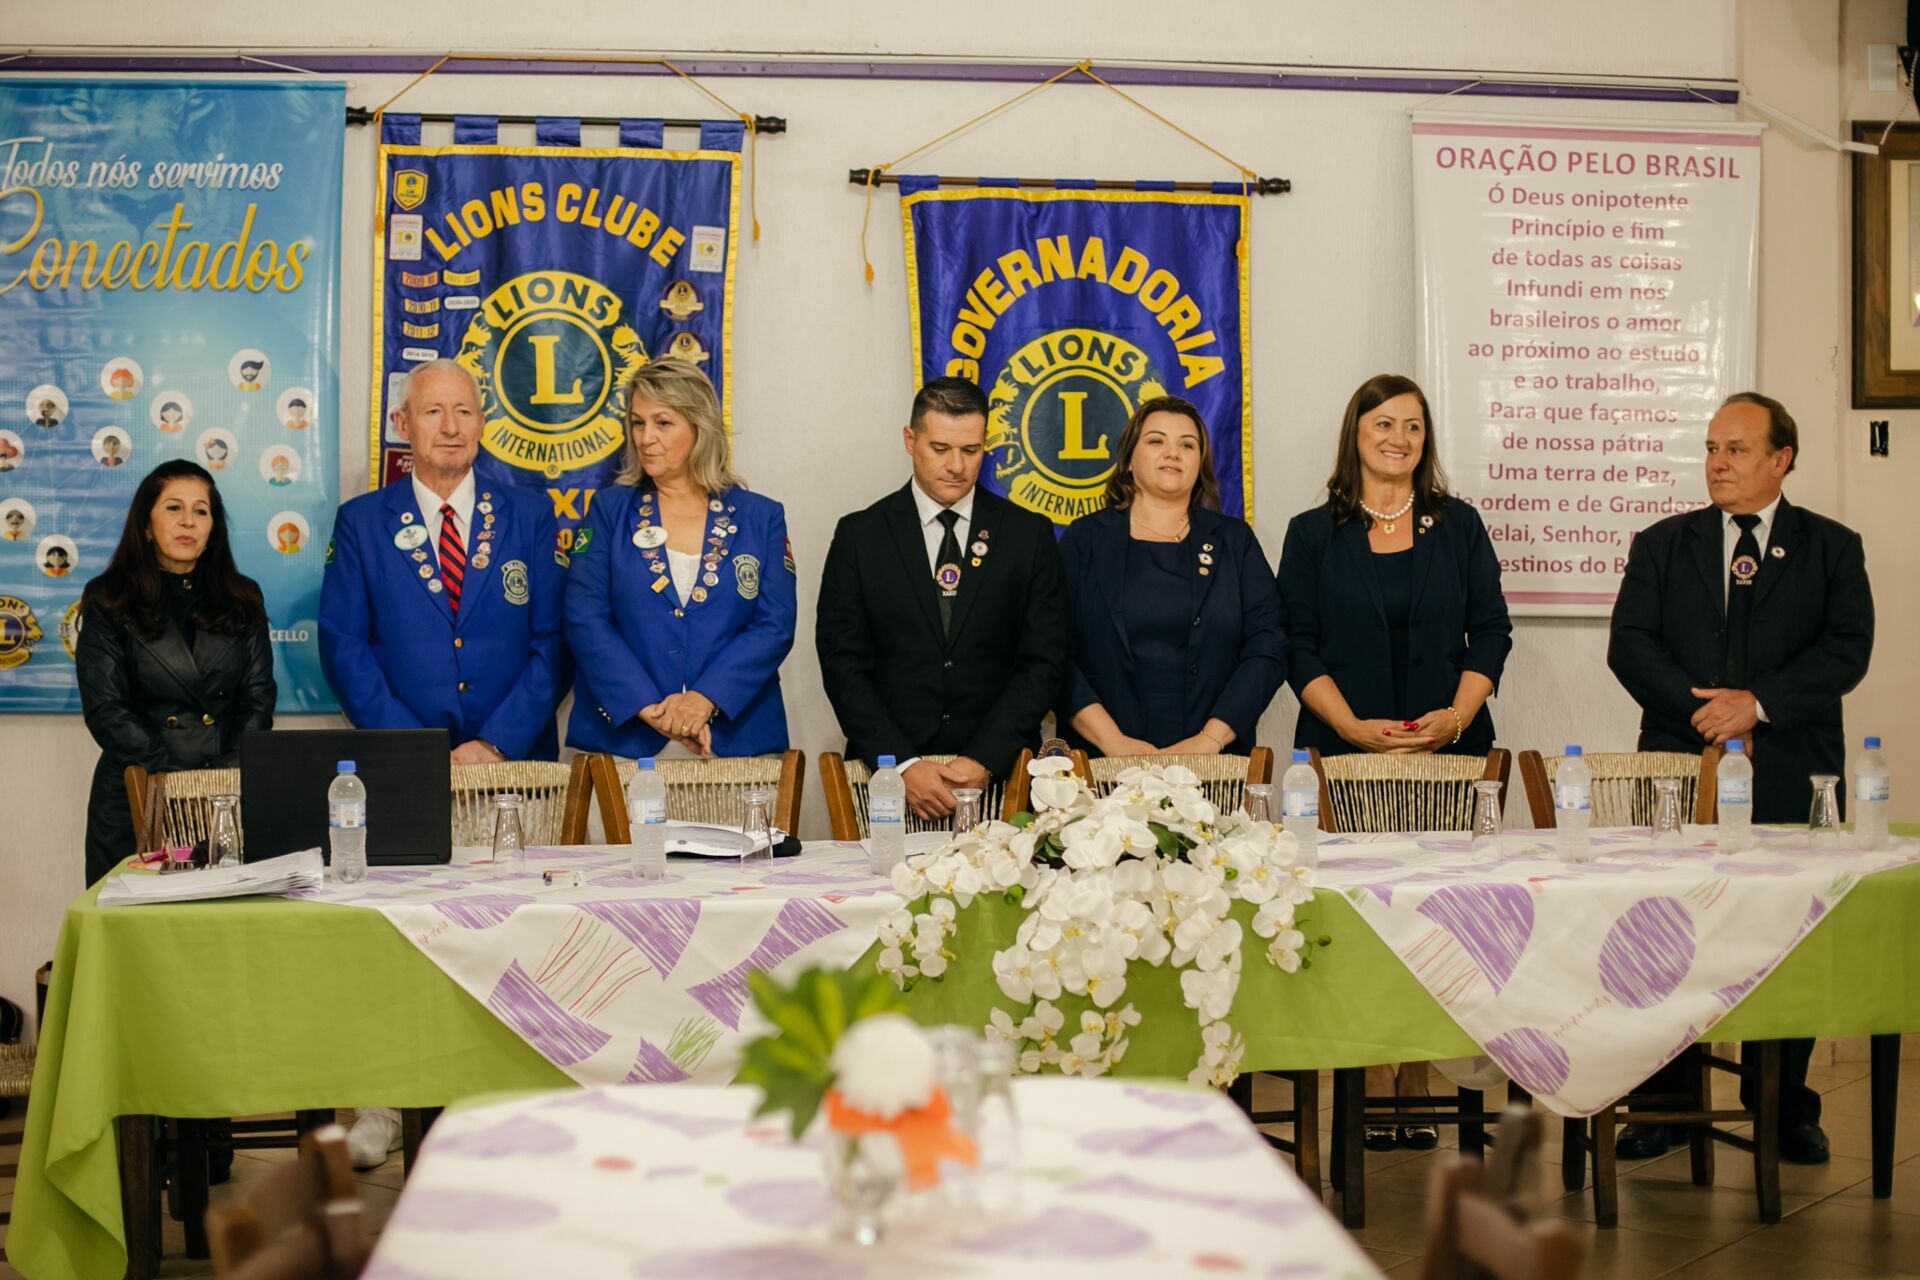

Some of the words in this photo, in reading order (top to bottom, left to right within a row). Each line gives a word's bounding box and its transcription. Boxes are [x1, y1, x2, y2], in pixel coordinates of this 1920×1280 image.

[0, 136, 80, 190] Todos
[88, 154, 141, 189] nós
[149, 153, 283, 190] servimos
[1435, 145, 1558, 176] ORAÇÃO
[1567, 152, 1636, 175] PELO
[1645, 154, 1741, 180] BRASIL
[1488, 183, 1504, 205] Ó
[1511, 188, 1565, 207] Deus
[1571, 191, 1689, 213] onipotente
[425, 182, 546, 261] LIONS
[555, 183, 686, 267] CLUBE
[1511, 218, 1606, 242] Princípio
[1611, 224, 1624, 239] e
[1630, 221, 1665, 241] fim
[1491, 248, 1519, 267] de
[1525, 249, 1584, 269] todas
[1590, 255, 1613, 270] as
[1619, 254, 1683, 272] coisas
[492, 277, 616, 322] LIONS
[1507, 280, 1583, 299] Infundi
[1590, 286, 1623, 300] em
[1629, 282, 1667, 302] nós
[945, 234, 1226, 389] GOVERNADORIA
[1490, 309, 1600, 331] brasileiros
[1606, 317, 1620, 331] o
[1626, 317, 1682, 332] amor
[1019, 334, 1140, 378] LIONS
[1468, 343, 1495, 359] ao
[1501, 342, 1590, 363] próximo
[1596, 345, 1623, 361] ao
[1629, 344, 1700, 363] estudo
[528, 335, 584, 404] L
[1513, 375, 1526, 389] e
[1533, 375, 1559, 390] ao
[1565, 373, 1661, 395] trabalho,
[1058, 391, 1109, 459] L
[1490, 402, 1537, 420] Para
[1543, 406, 1583, 425] que
[1590, 402, 1678, 427] façamos
[491, 426, 616, 462] INTERNATIONAL
[1502, 432, 1529, 451] de
[1535, 437, 1595, 452] nossa
[1602, 434, 1664, 457] pátria
[1488, 463, 1538, 481] Uma
[1544, 466, 1596, 482] terra
[1602, 464, 1629, 482] de
[1635, 466, 1677, 486] Paz,
[1019, 481, 1108, 516] INTERNATIO
[1480, 493, 1551, 513] ordem
[1557, 498, 1569, 513] e
[1576, 494, 1603, 513] de
[1542, 525, 1622, 545] Senhor,
[1499, 555, 1573, 574] estinos
[1579, 555, 1606, 574] do
